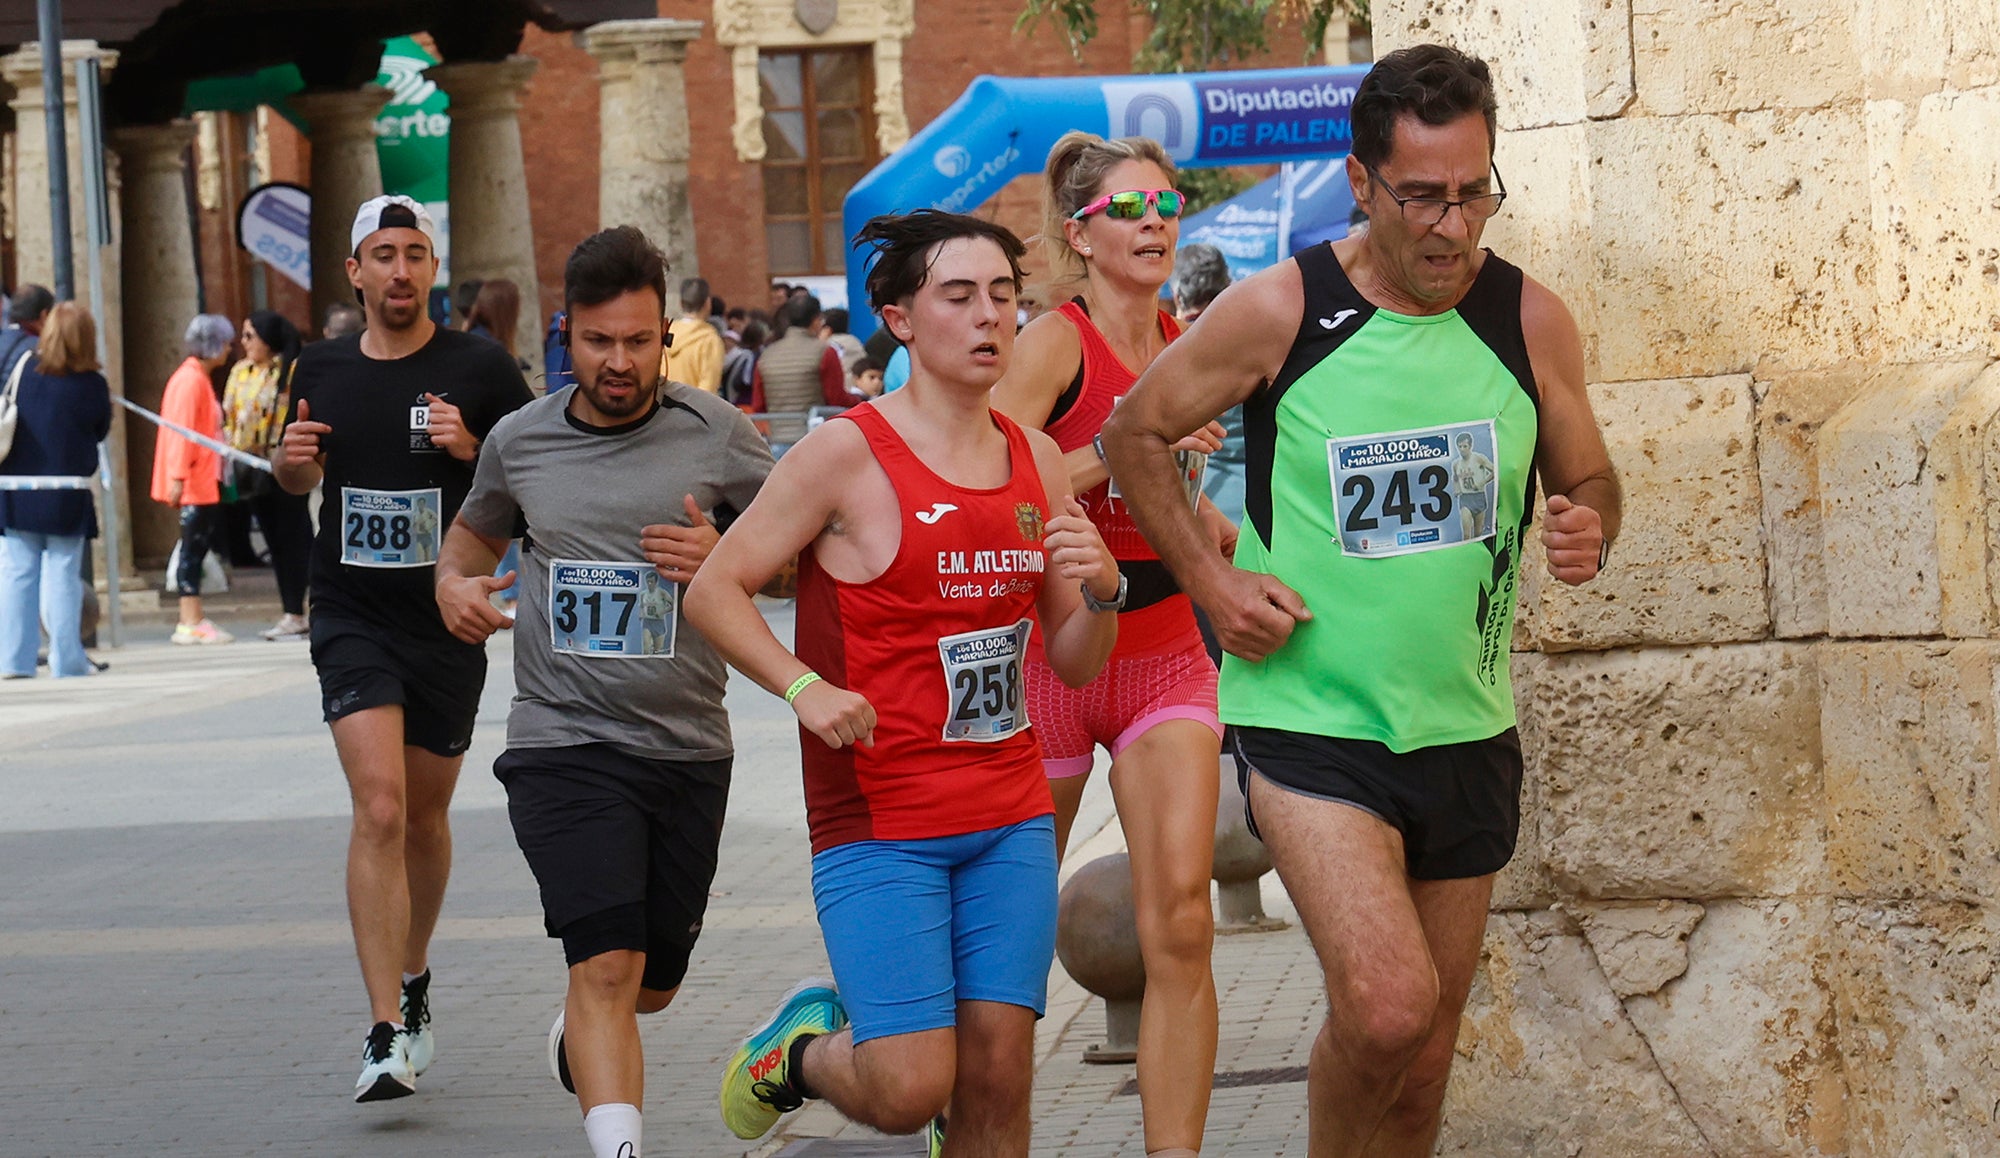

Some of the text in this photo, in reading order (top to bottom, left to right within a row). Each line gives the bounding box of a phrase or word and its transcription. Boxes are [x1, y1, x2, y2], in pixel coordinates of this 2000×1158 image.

[1205, 82, 1356, 117] Diputación
[1209, 117, 1352, 148] DE PALEN
[1347, 447, 1441, 467] MARIANO HARO
[1367, 439, 1419, 455] 10.000
[1342, 464, 1453, 532] 243
[347, 512, 411, 550] 288
[576, 568, 616, 579] 10.000
[938, 549, 1044, 574] E.M. ATLETISMO
[939, 580, 983, 598] Venta
[988, 578, 1006, 597] de
[556, 589, 638, 636] 317
[969, 636, 1007, 651] 10.000
[955, 659, 1018, 720] 258
